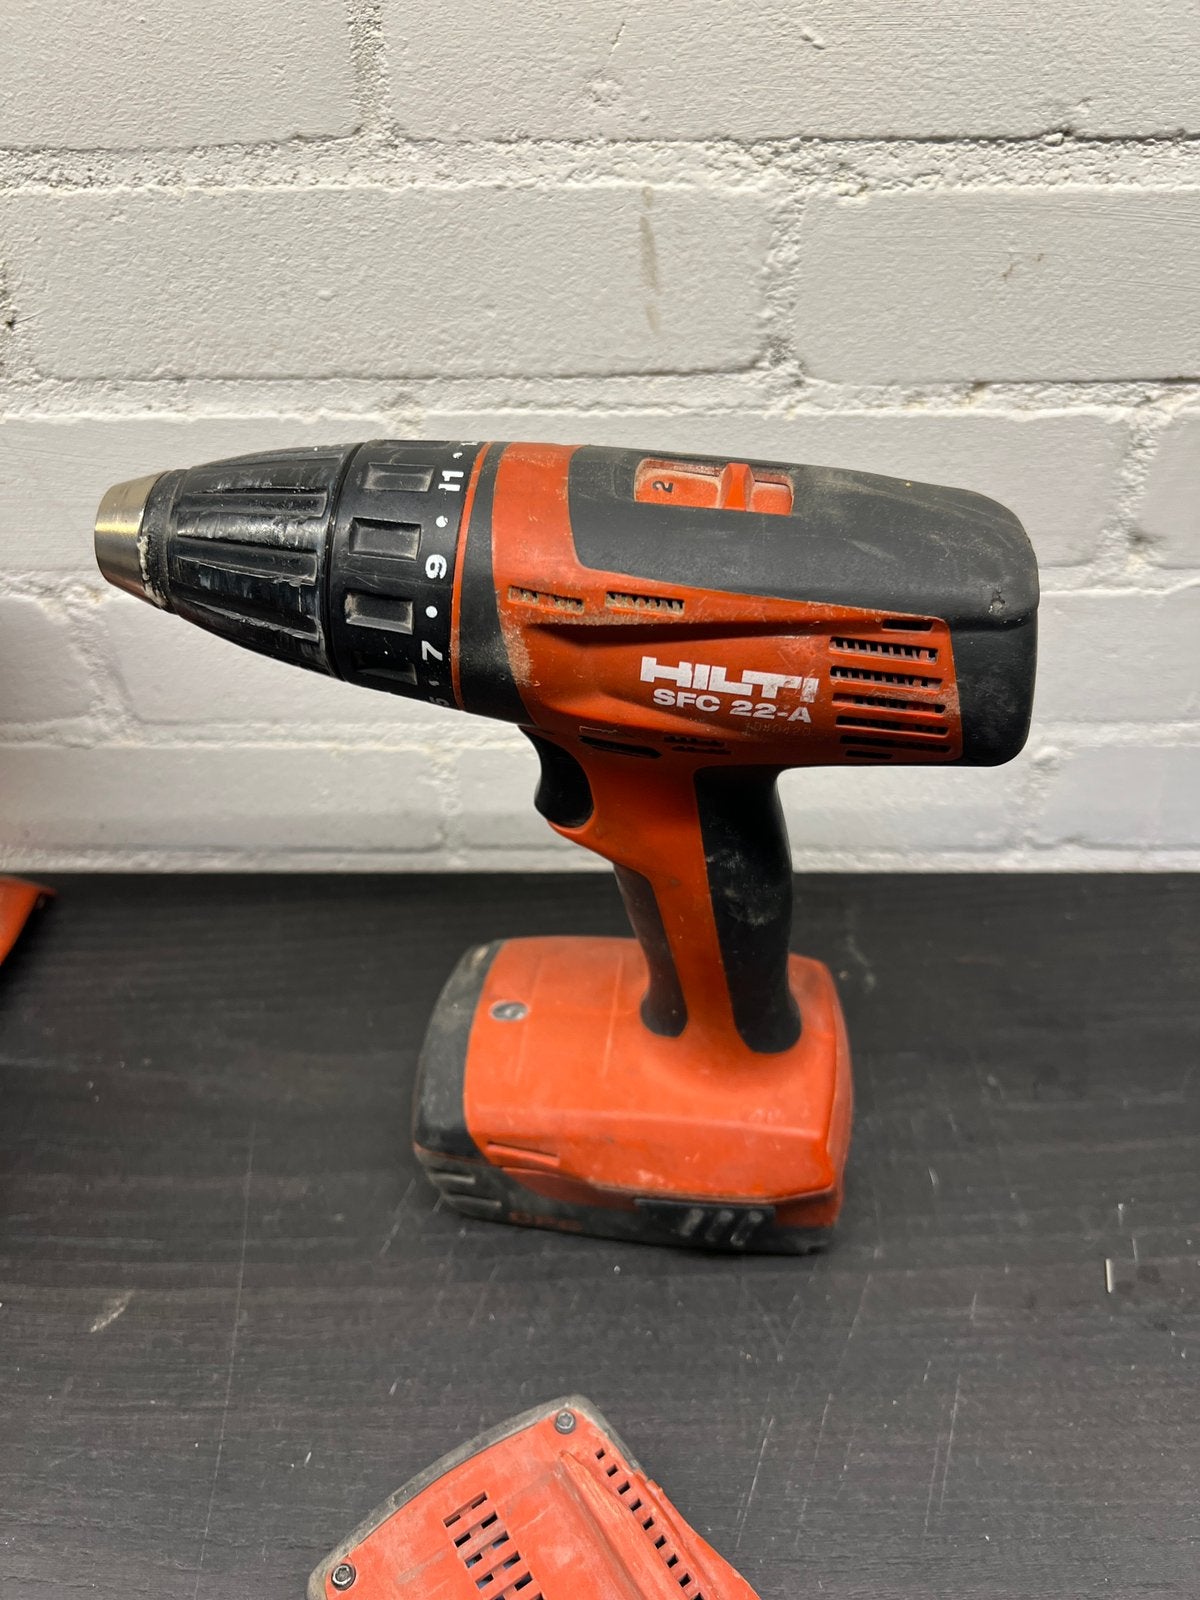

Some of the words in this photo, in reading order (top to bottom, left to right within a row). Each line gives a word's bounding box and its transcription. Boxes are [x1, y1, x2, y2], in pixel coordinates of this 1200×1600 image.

[438, 470, 464, 492] 11
[652, 480, 674, 494] 2
[425, 554, 448, 579] 9
[421, 640, 443, 661] 7
[640, 656, 820, 703] HILTI
[653, 688, 721, 713] SFC
[729, 700, 812, 724] 22-A
